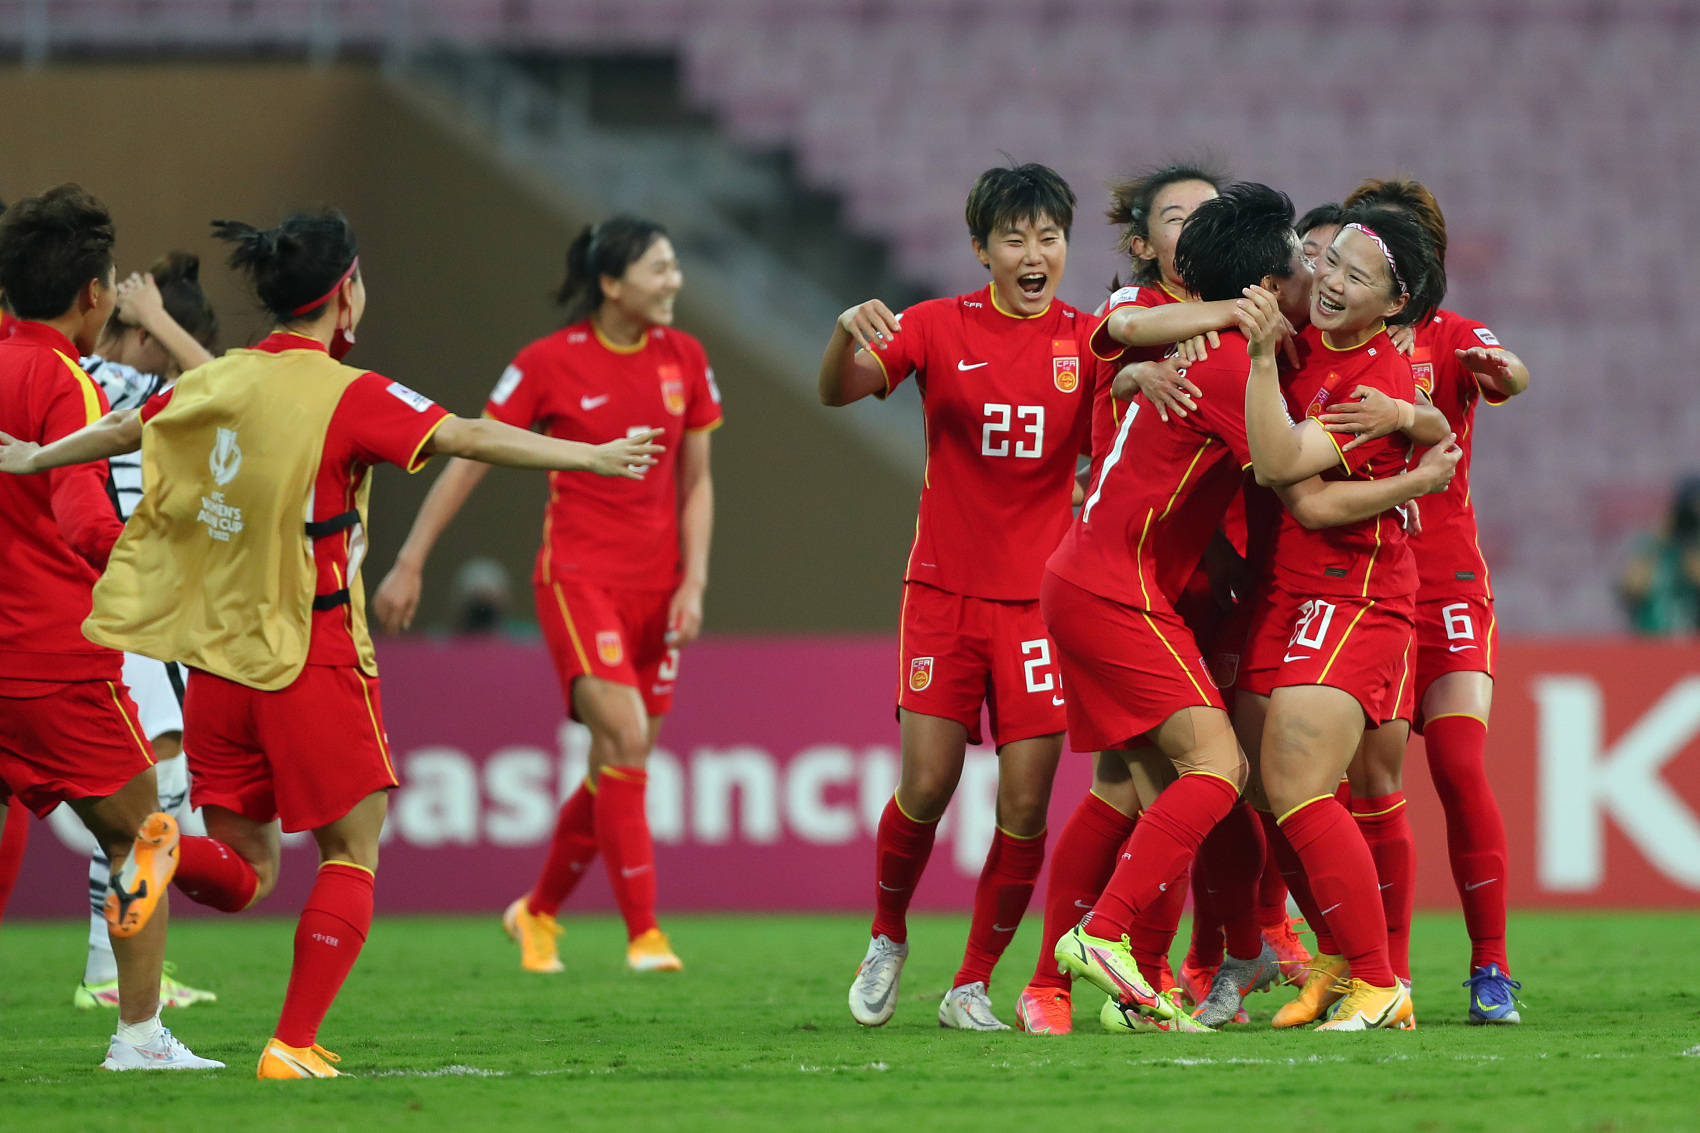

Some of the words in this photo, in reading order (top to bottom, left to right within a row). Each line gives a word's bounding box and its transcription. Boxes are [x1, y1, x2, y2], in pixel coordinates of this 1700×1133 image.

[982, 403, 1045, 459] 23
[219, 518, 244, 534] CUP
[1286, 600, 1336, 650] 20
[1442, 603, 1475, 640] 6
[1021, 638, 1063, 693] 2
